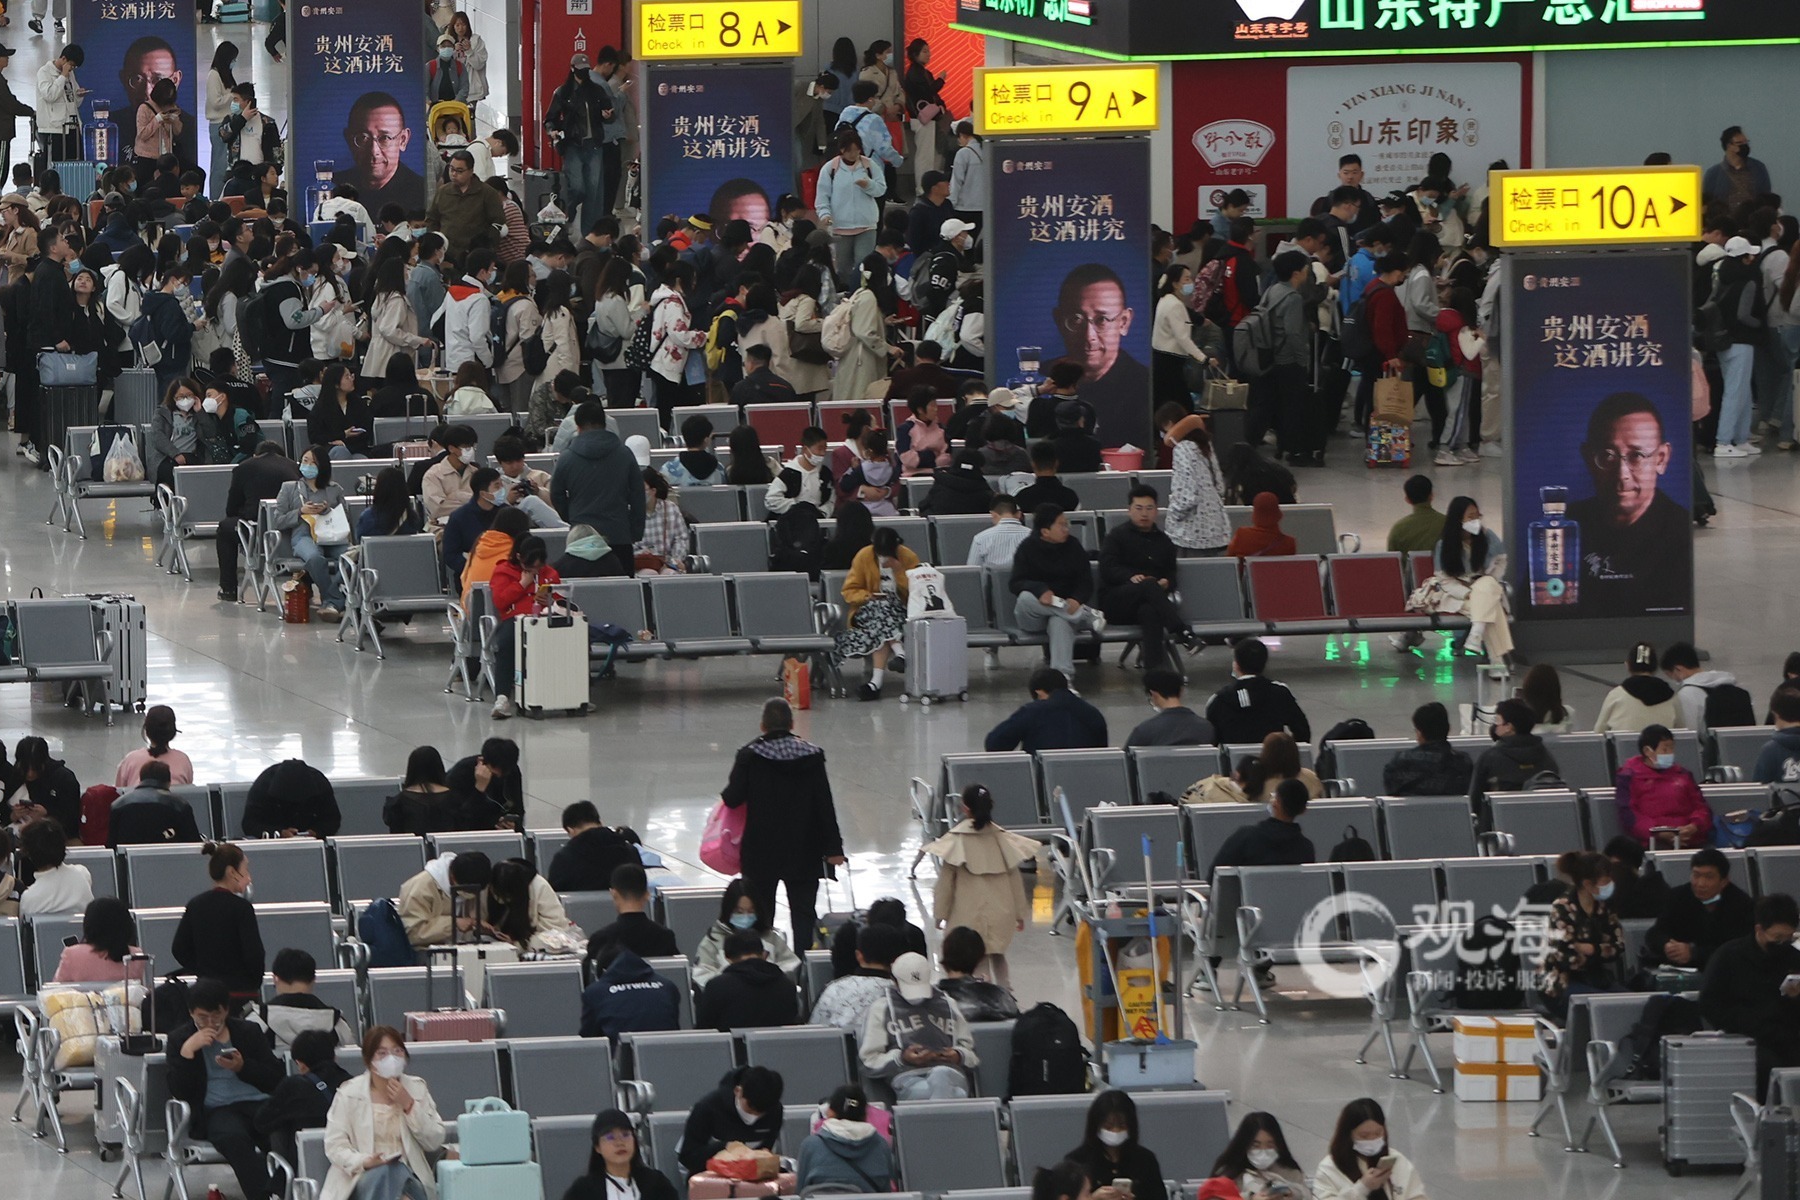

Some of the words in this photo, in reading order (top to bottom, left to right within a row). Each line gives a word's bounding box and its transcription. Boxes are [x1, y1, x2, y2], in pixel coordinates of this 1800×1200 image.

[100, 1, 176, 20] 这酒讲究
[647, 13, 704, 33] 检票口
[719, 11, 741, 47] 8
[752, 21, 768, 46] A
[1234, 21, 1308, 35] 山东老字号
[314, 34, 394, 54] 贵州安酒
[648, 39, 682, 50] Check
[692, 38, 704, 48] in
[324, 54, 404, 75] 这酒讲究
[991, 84, 1052, 104] 检票口
[1068, 81, 1091, 121] 9
[1104, 91, 1122, 119] A
[1342, 91, 1367, 111] YIN
[1370, 83, 1416, 101] XIANG
[1420, 84, 1434, 97] JI
[1438, 89, 1466, 109] NAN
[671, 115, 760, 138] 贵州安酒
[991, 112, 1029, 125] Check
[1039, 112, 1053, 123] in
[1349, 116, 1460, 146] 山东印象
[682, 137, 771, 159] 这酒讲究
[1017, 194, 1114, 220] 贵州安酒
[1510, 187, 1579, 211] 检票口
[1029, 218, 1126, 243] 这酒讲究
[1509, 219, 1552, 233] Check
[1565, 219, 1580, 231] in
[1540, 314, 1648, 343] 贵州安酒
[1554, 342, 1663, 368] 这酒讲究
